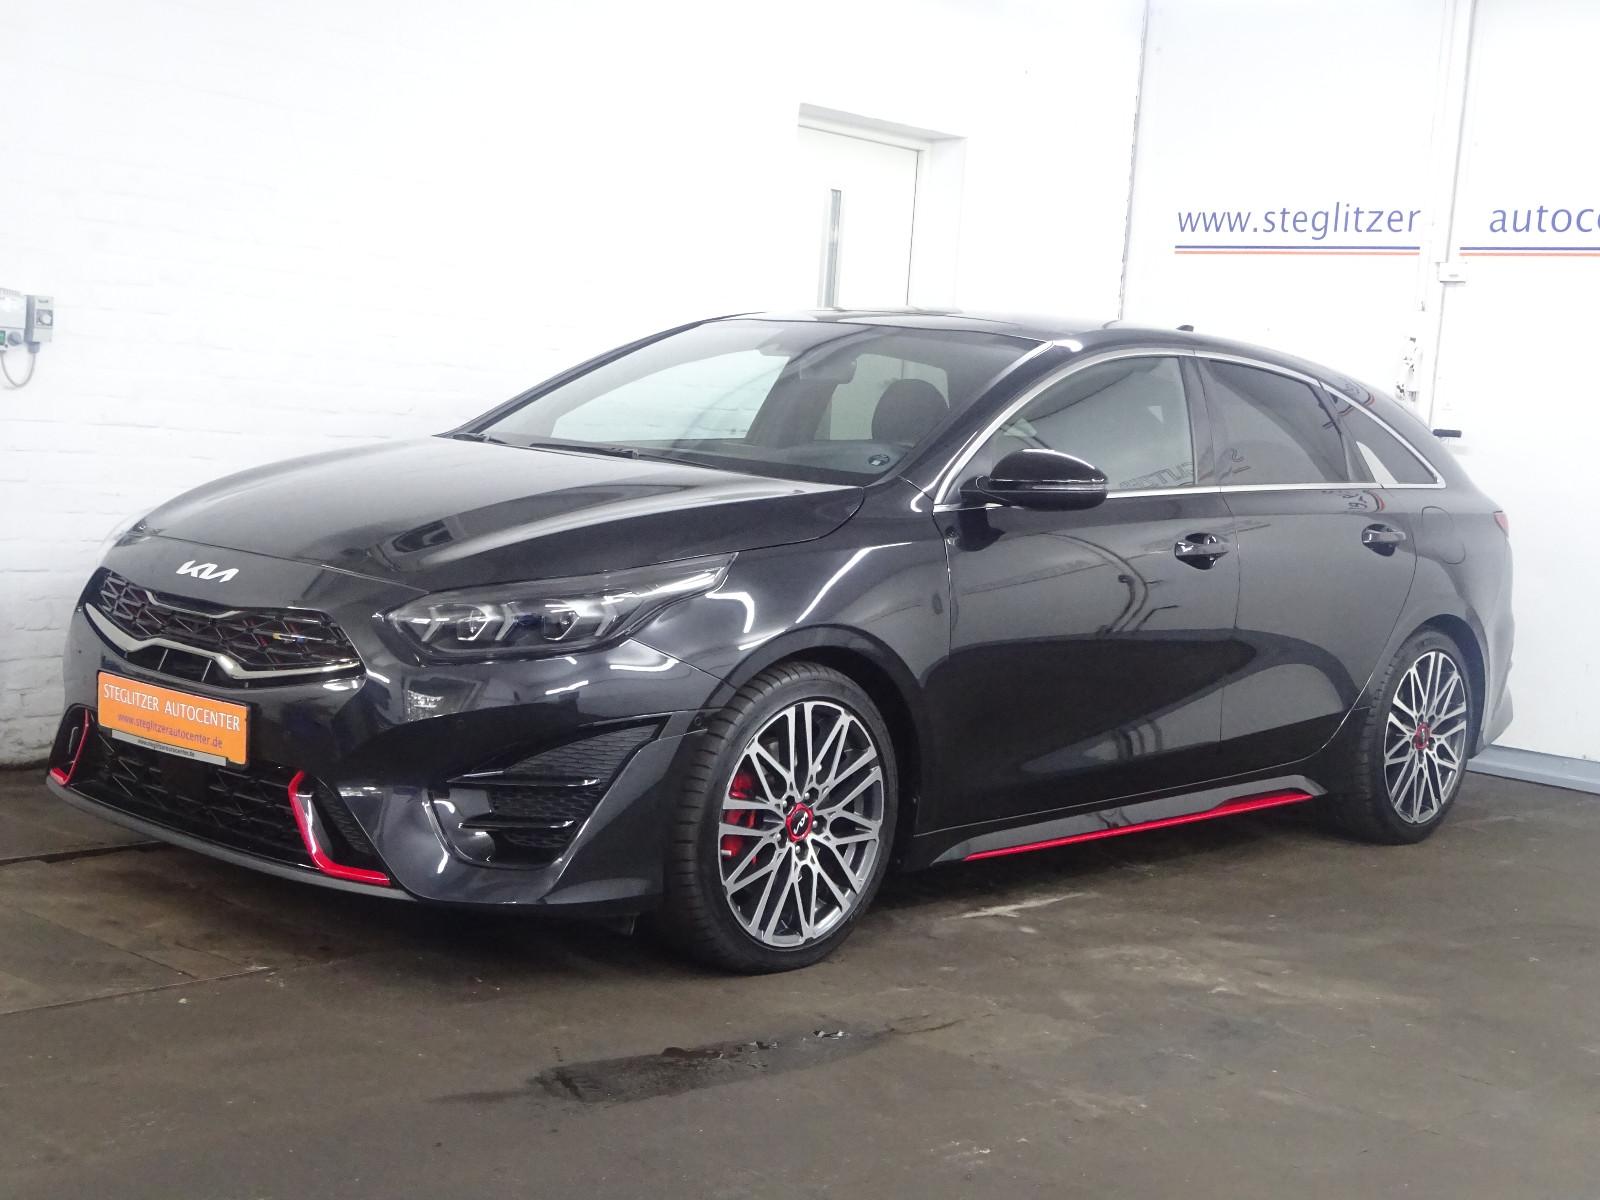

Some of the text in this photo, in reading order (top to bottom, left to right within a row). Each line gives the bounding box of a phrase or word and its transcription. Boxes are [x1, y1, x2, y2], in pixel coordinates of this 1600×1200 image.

[1177, 201, 1600, 240] www.steglitzer autoc
[103, 683, 240, 731] STEGLITZER AUTOCENTER
[117, 712, 223, 749] www.steglitzerautocenter.de
